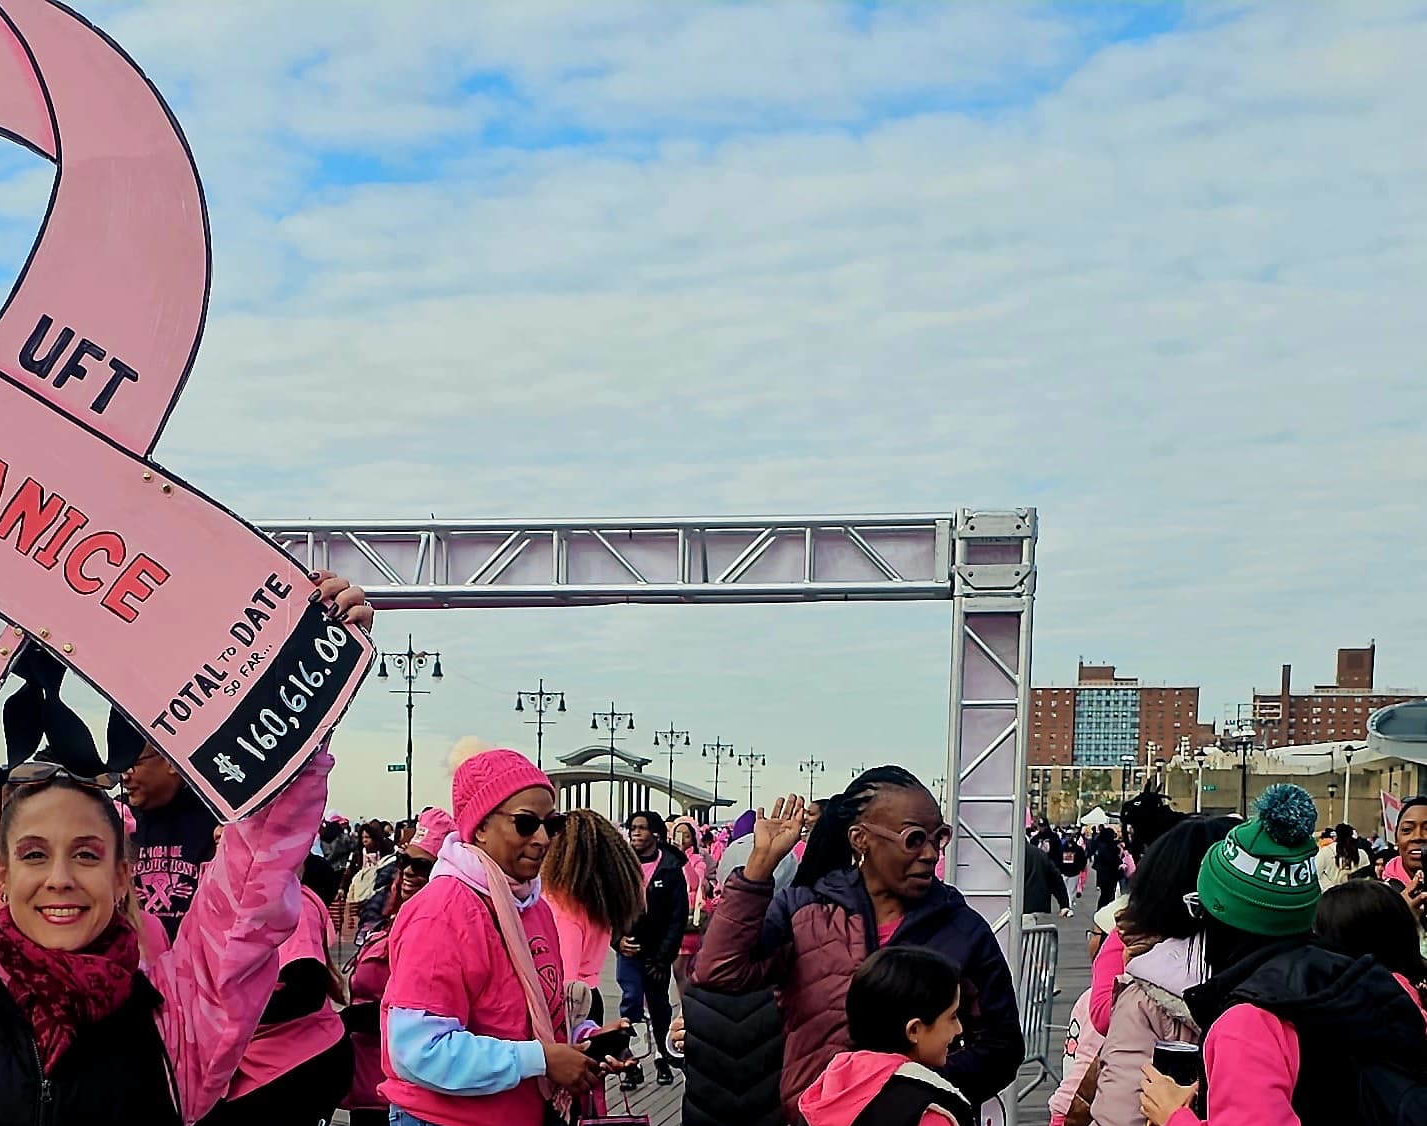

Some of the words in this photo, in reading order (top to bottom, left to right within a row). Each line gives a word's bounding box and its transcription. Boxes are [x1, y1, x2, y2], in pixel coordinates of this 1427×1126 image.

[18, 314, 139, 414] UFT
[150, 663, 228, 736] TOTAL
[217, 647, 237, 662] TO
[229, 573, 293, 647] DATE
[224, 679, 241, 696] SO
